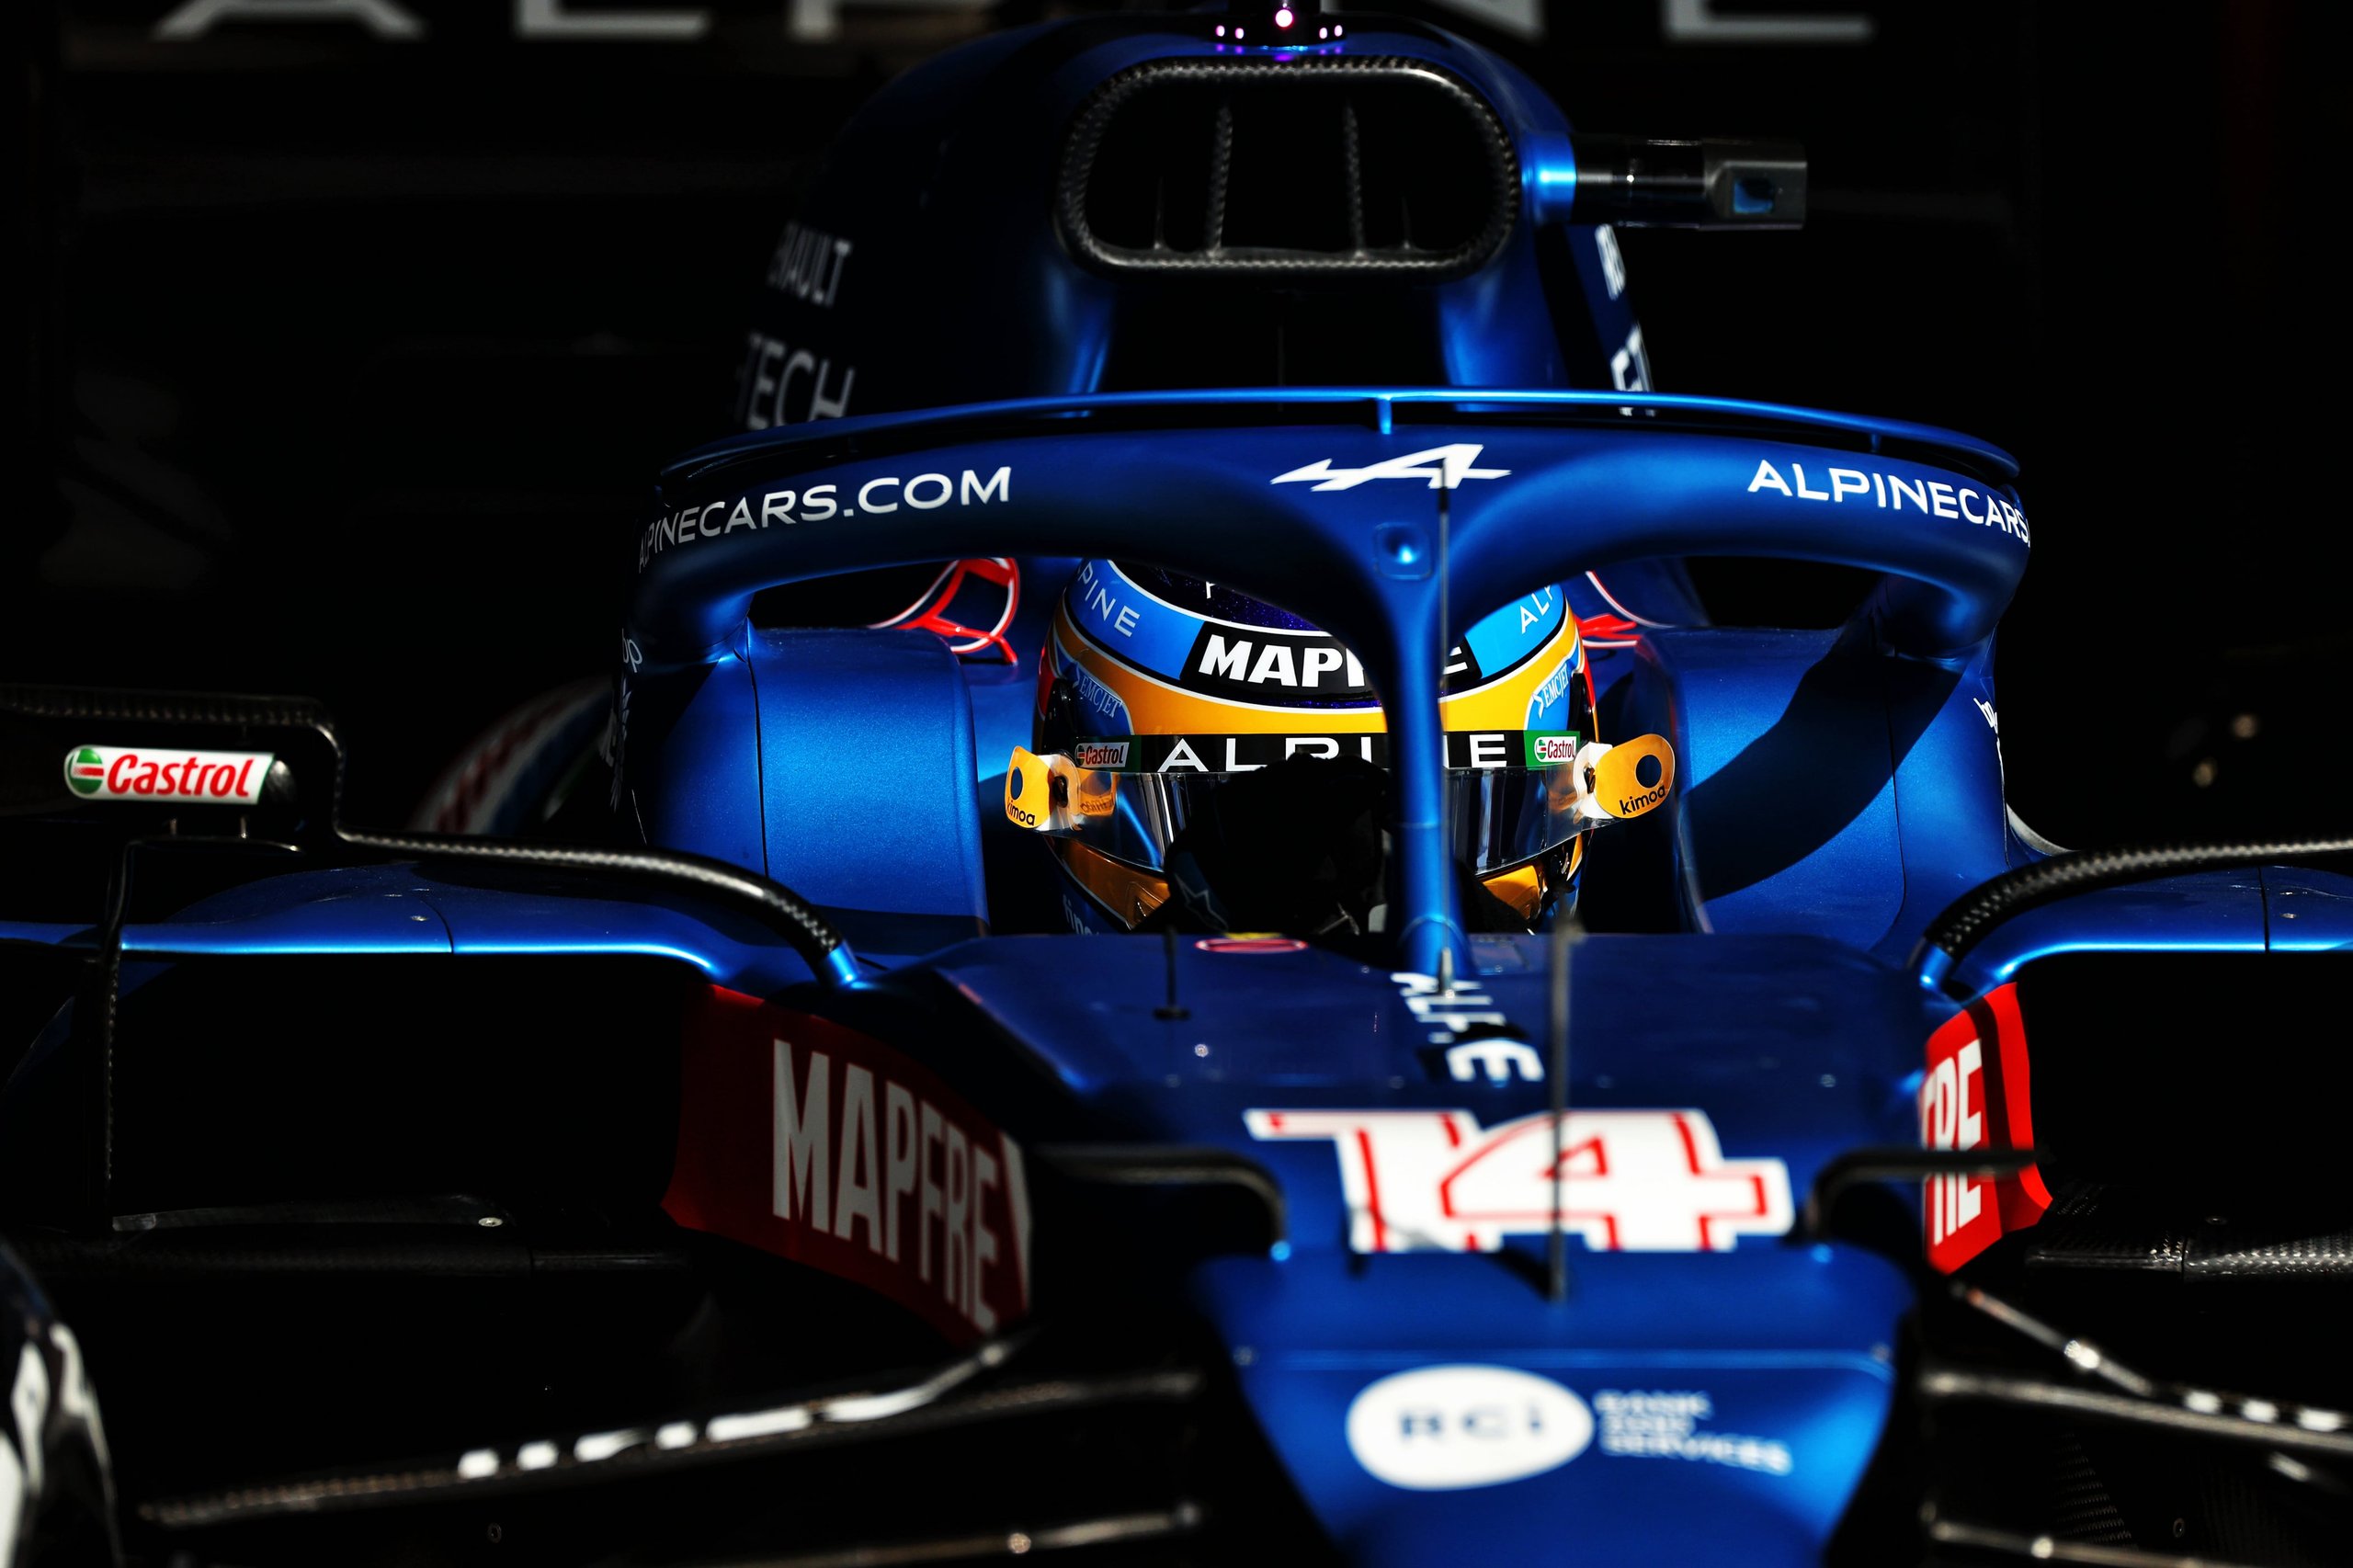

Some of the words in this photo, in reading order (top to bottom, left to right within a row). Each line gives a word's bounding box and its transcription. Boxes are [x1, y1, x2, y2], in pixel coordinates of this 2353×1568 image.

[639, 466, 1012, 574] ALPINECARS.COM
[1747, 459, 2030, 549] ALPINECARS
[1076, 561, 1141, 638] PINE
[108, 755, 254, 797] Castrol
[1086, 745, 1124, 765] Castrol
[1157, 733, 1507, 772] ALPIE
[1547, 741, 1575, 759] Castrol
[1619, 785, 1665, 815] kimoa
[772, 1037, 1000, 1336] MAPFRE
[1243, 1108, 1795, 1254] 14
